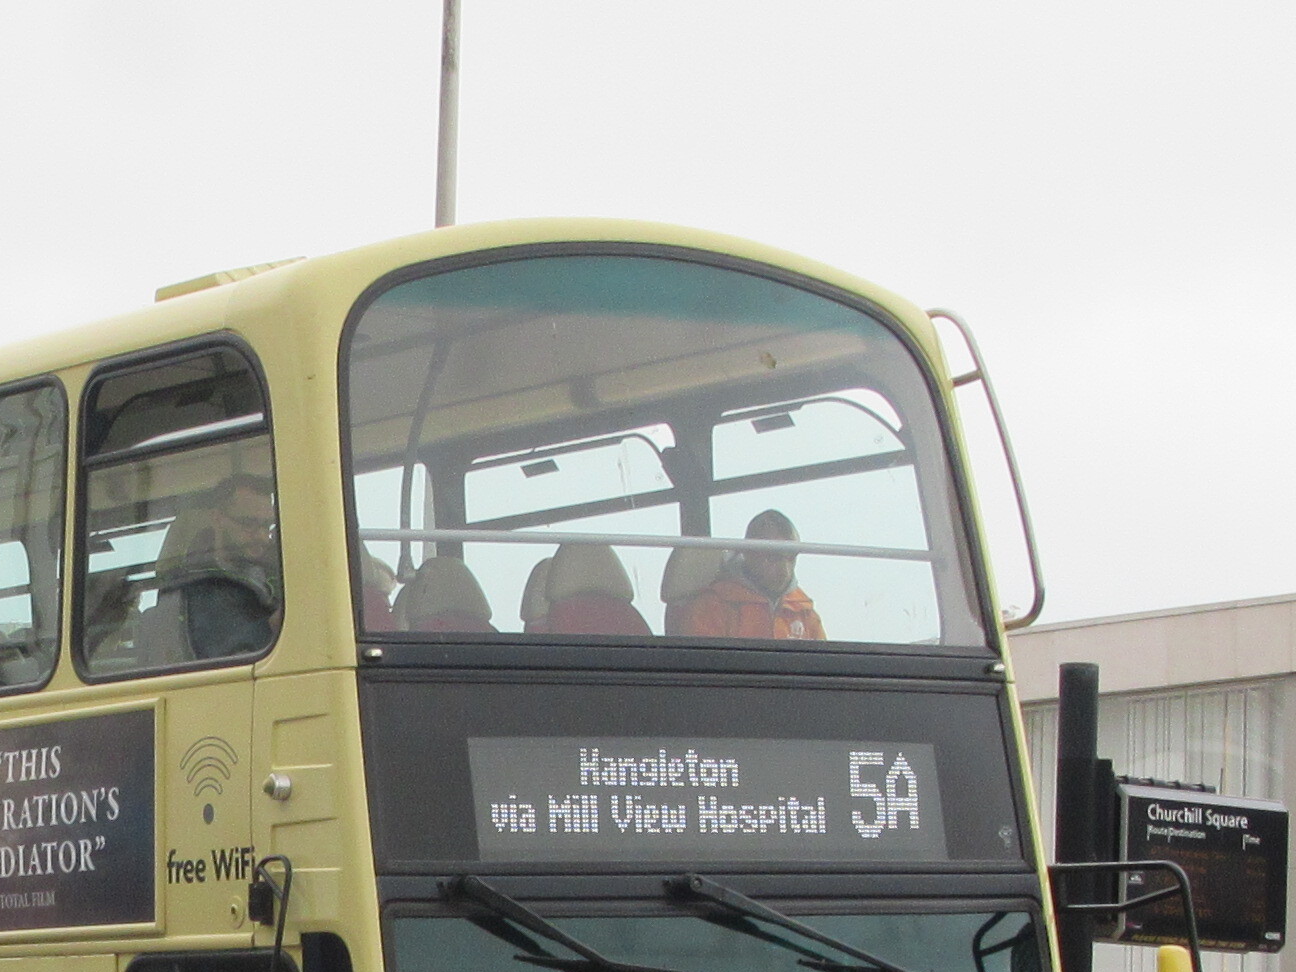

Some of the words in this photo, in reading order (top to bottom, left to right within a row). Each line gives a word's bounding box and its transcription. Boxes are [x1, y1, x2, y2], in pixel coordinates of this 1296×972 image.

[579, 747, 740, 787] Hangleton
[849, 751, 920, 839] 5A
[490, 794, 536, 834] via
[548, 794, 599, 834] Mill
[610, 795, 688, 834] View
[697, 796, 827, 834] Hospital
[1147, 803, 1203, 824] Churchill
[1205, 808, 1249, 831] Square
[166, 848, 207, 885] free
[210, 844, 256, 881] WiFi
[32, 891, 56, 908] FILM
